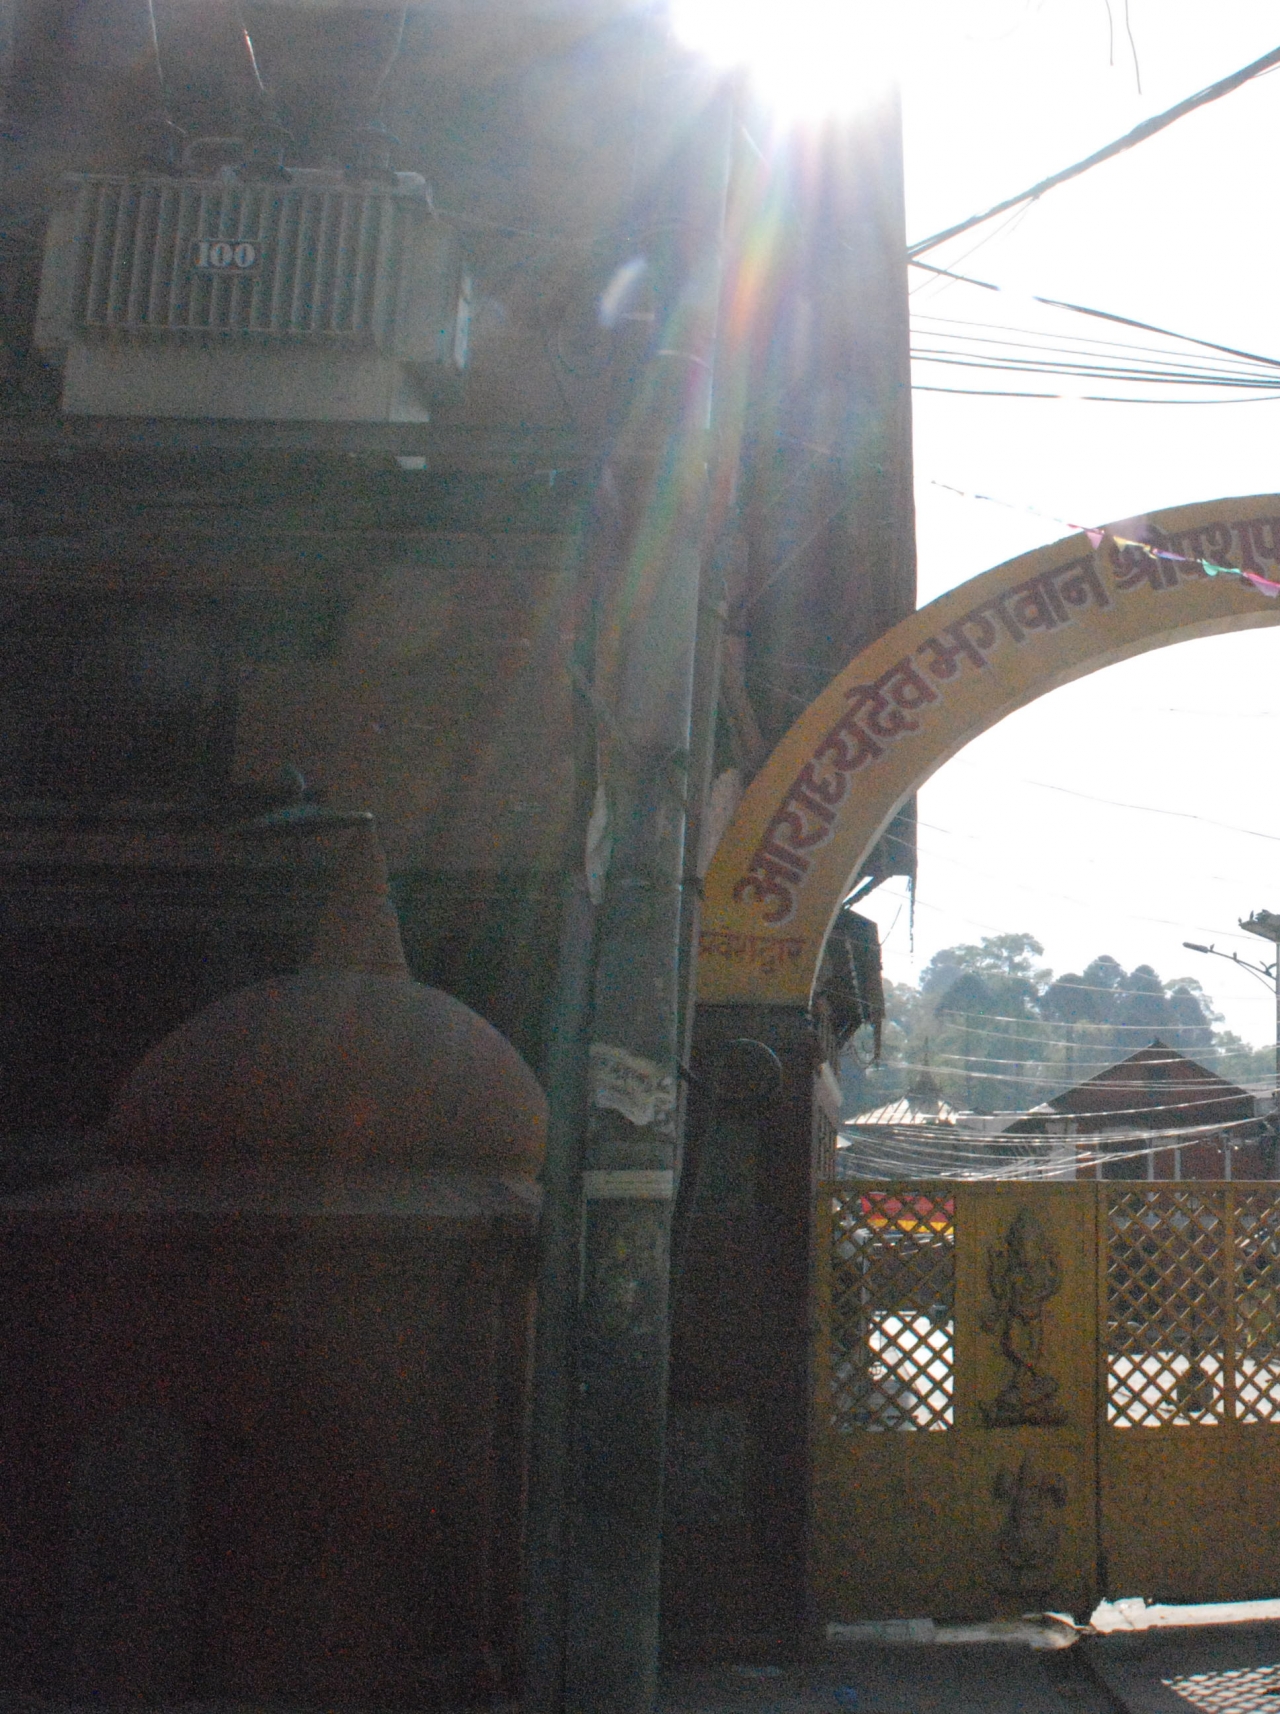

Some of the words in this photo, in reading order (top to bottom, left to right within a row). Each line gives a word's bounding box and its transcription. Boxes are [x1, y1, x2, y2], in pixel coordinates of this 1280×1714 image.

[198, 241, 256, 268] 100
[732, 657, 940, 924] आराध्यदेव
[916, 551, 1112, 679] भगवान
